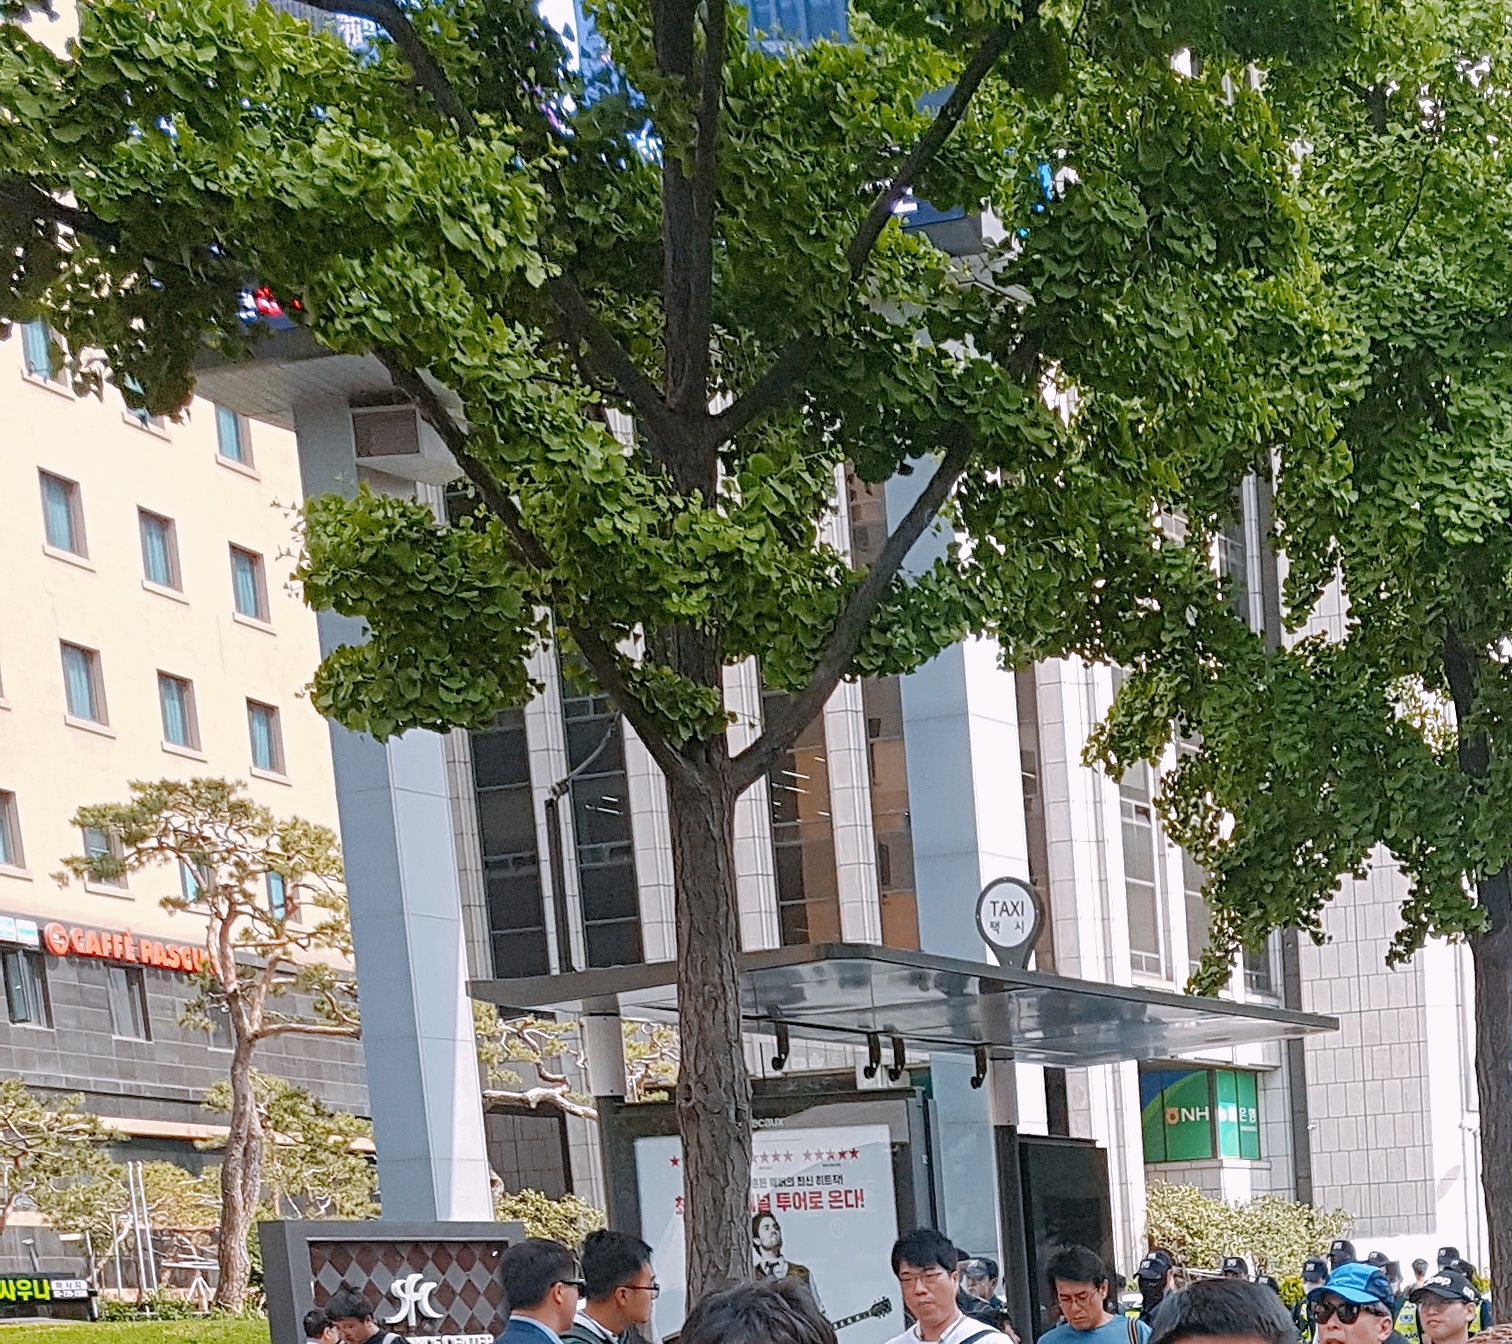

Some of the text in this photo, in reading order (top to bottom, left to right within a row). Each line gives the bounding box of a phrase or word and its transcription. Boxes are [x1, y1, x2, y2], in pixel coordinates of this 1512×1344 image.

[990, 901, 1024, 917] TAXI
[70, 927, 136, 963] CAFFÈ
[1181, 1106, 1210, 1122] NH
[776, 1190, 824, 1211] 투어로
[828, 1188, 865, 1209] 온다!
